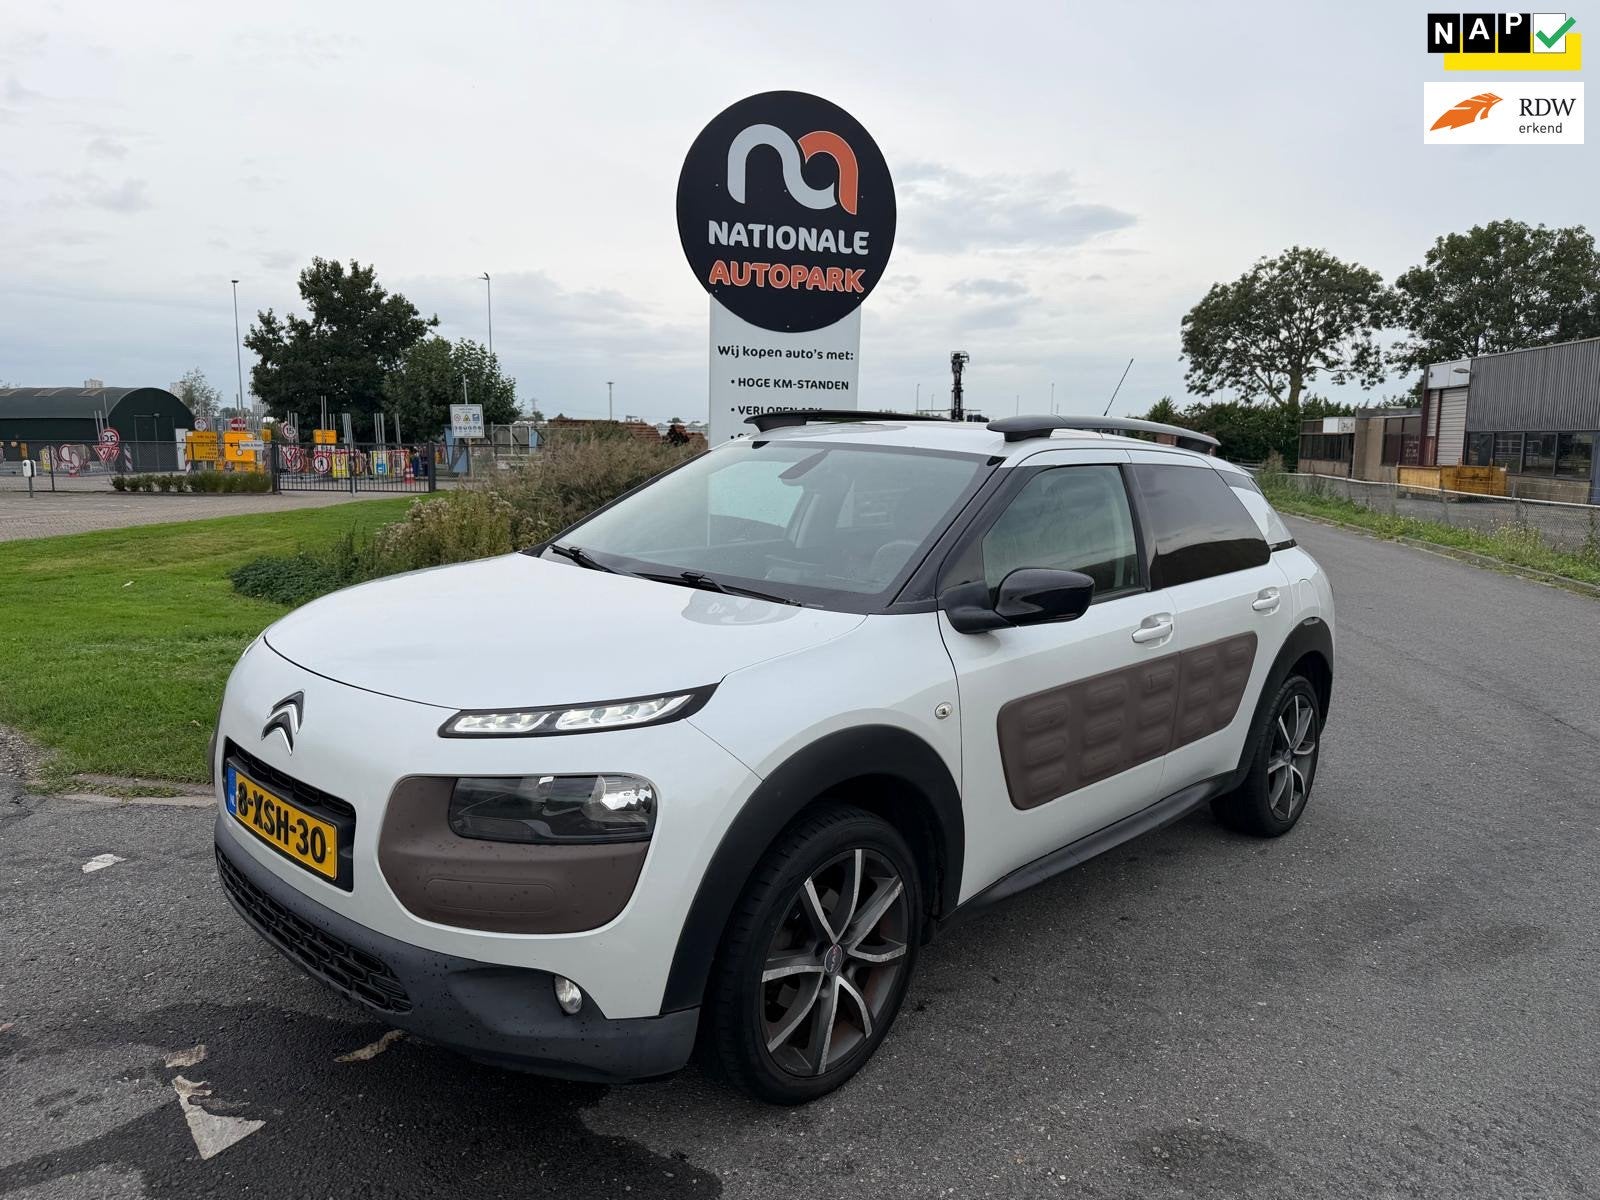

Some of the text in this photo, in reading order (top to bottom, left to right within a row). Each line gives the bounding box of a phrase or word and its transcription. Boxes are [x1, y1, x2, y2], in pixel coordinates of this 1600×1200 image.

[708, 220, 870, 255] NATIONALE
[708, 260, 866, 293] AUTOPARK
[717, 345, 854, 361] Wij kopen auto's met:
[738, 377, 849, 391] HOGE KM-STANDEN
[237, 781, 327, 864] 8-XSH-30
